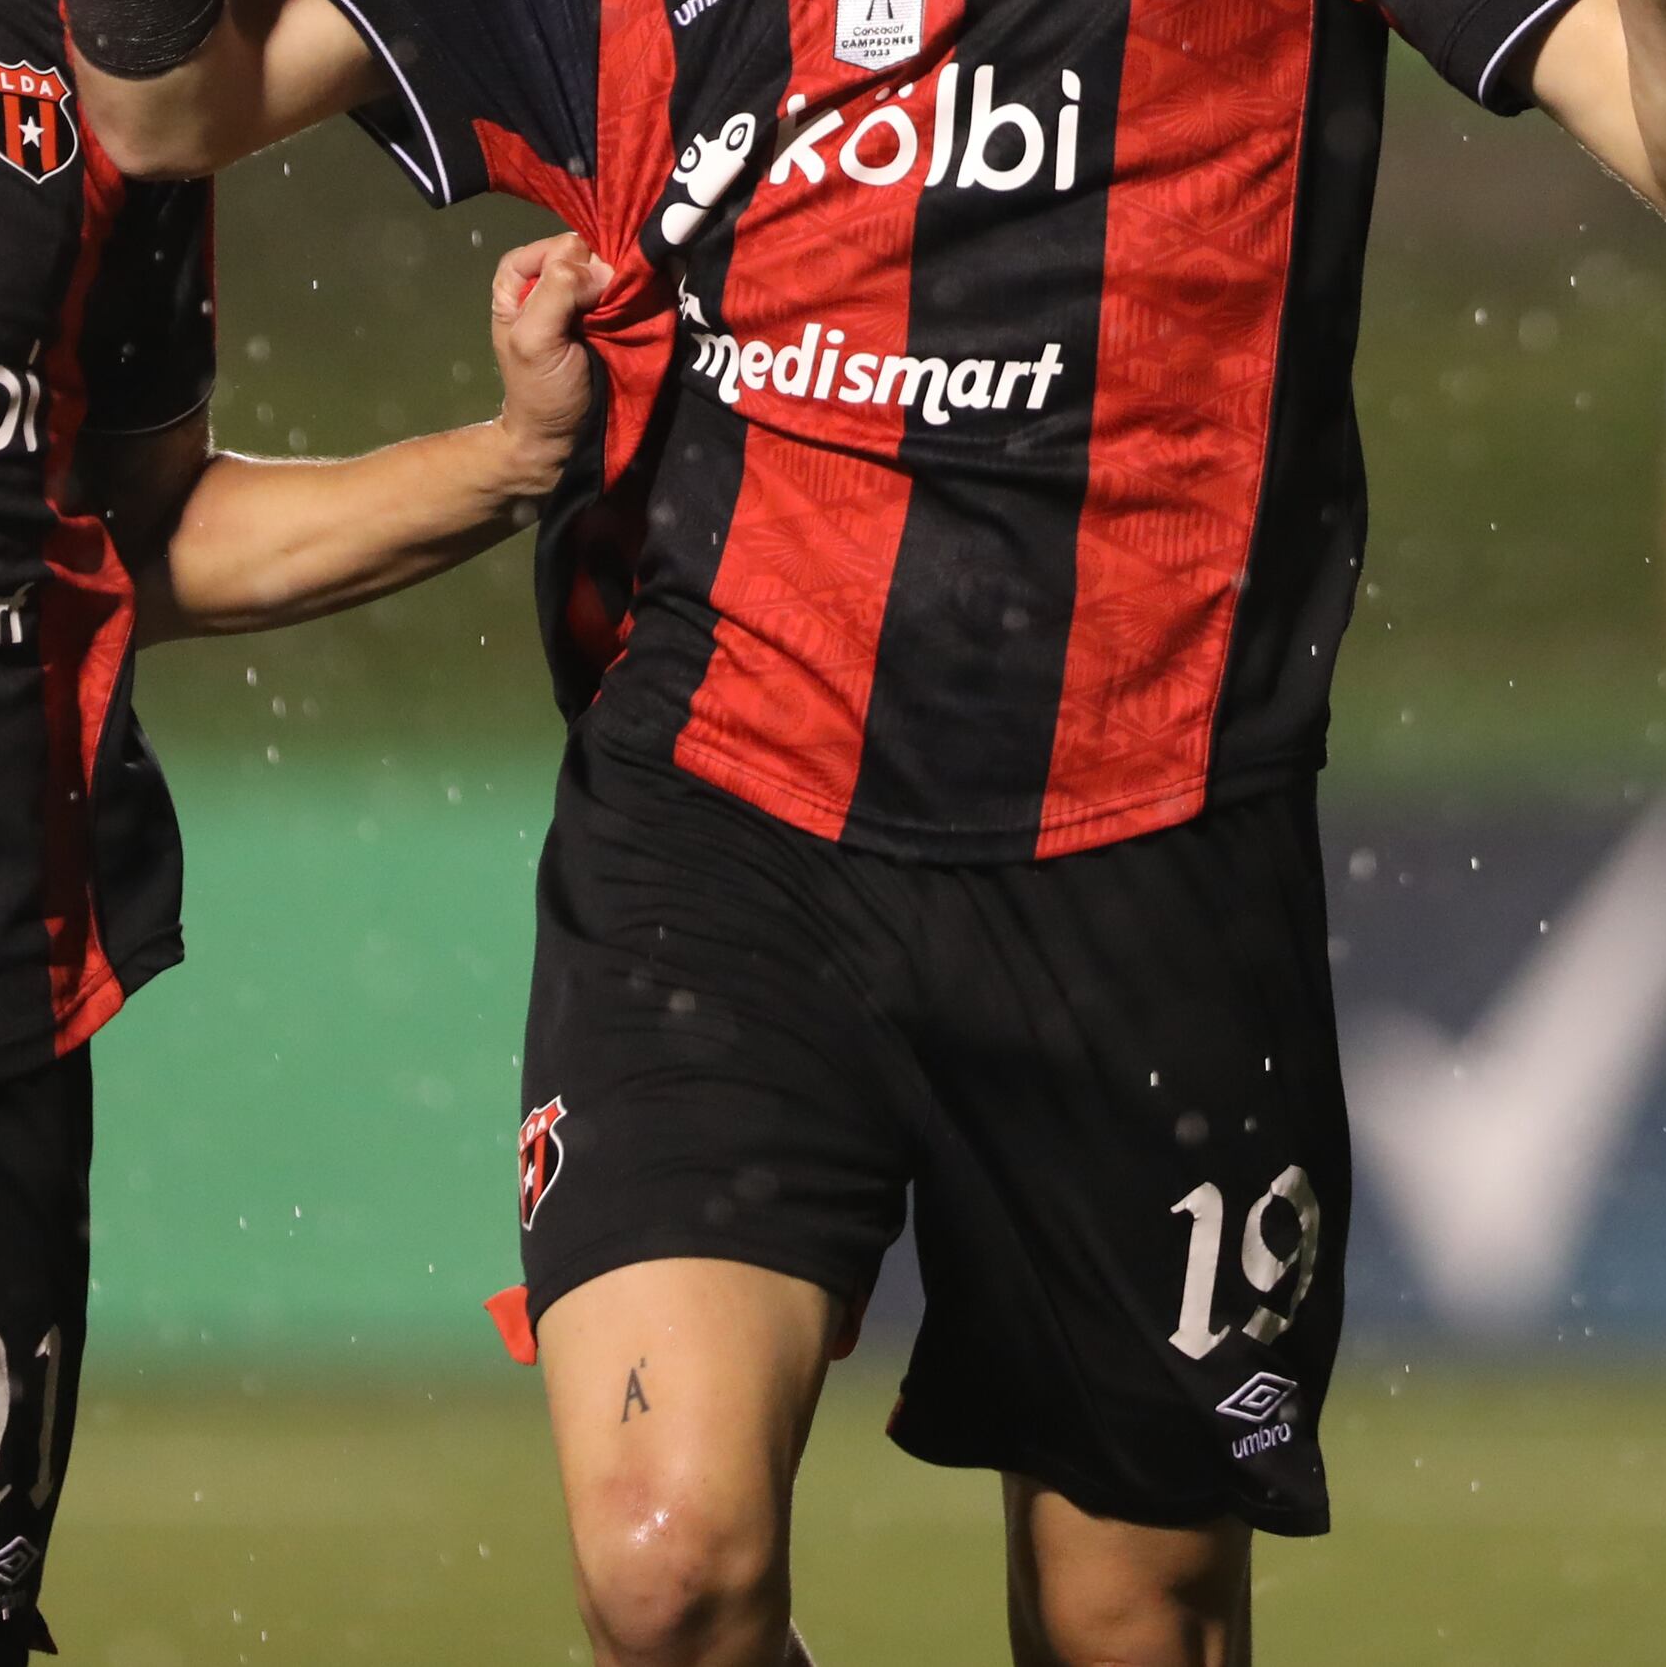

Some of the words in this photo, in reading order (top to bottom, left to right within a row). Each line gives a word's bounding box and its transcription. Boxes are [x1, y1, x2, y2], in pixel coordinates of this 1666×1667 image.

[841, 35, 914, 49] CAMPEONES
[0, 72, 54, 97] LDA
[768, 62, 1082, 192] kölbi
[690, 322, 1064, 426] medismart
[1168, 1164, 1321, 1361] 19
[1233, 1422, 1293, 1460] umbro
